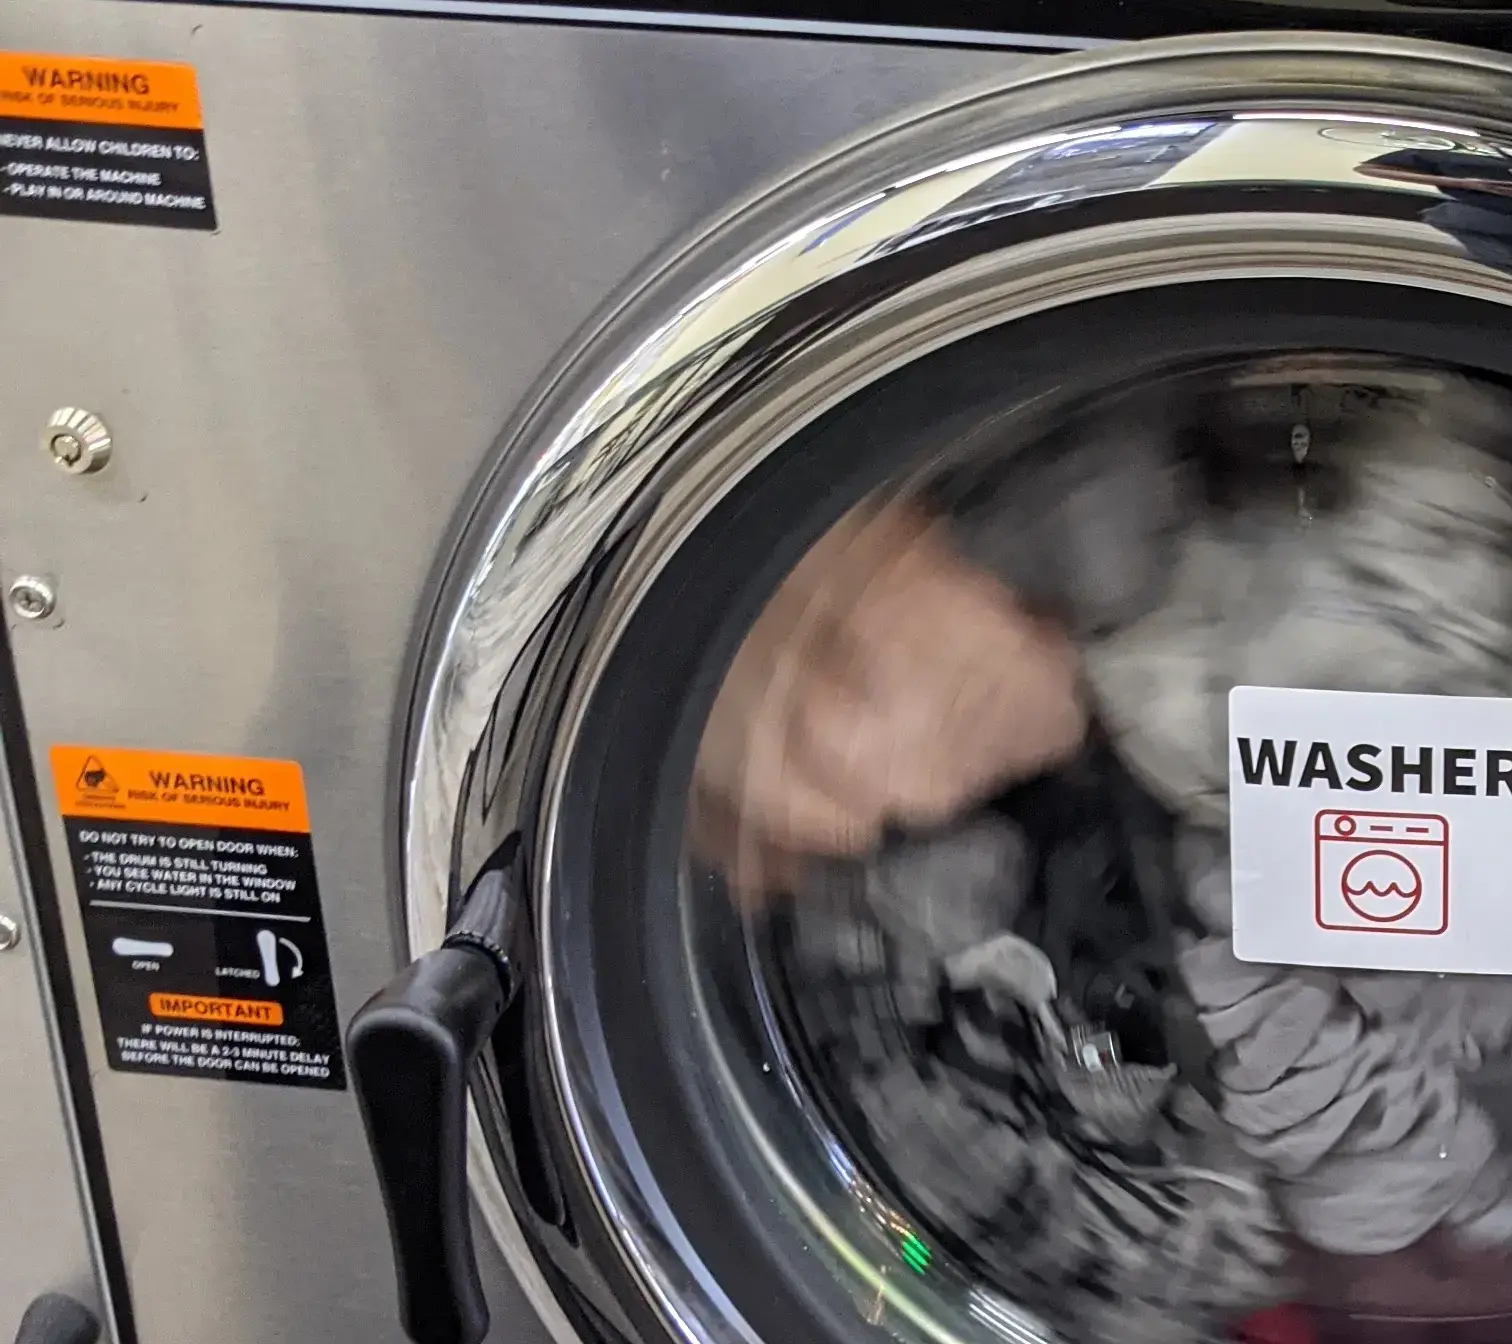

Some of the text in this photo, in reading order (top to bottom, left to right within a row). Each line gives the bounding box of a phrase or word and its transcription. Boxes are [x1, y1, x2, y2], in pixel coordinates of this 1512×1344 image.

[22, 66, 149, 95] WARNING
[149, 771, 264, 796] WARNING
[160, 999, 272, 1020] IMPORTANT
